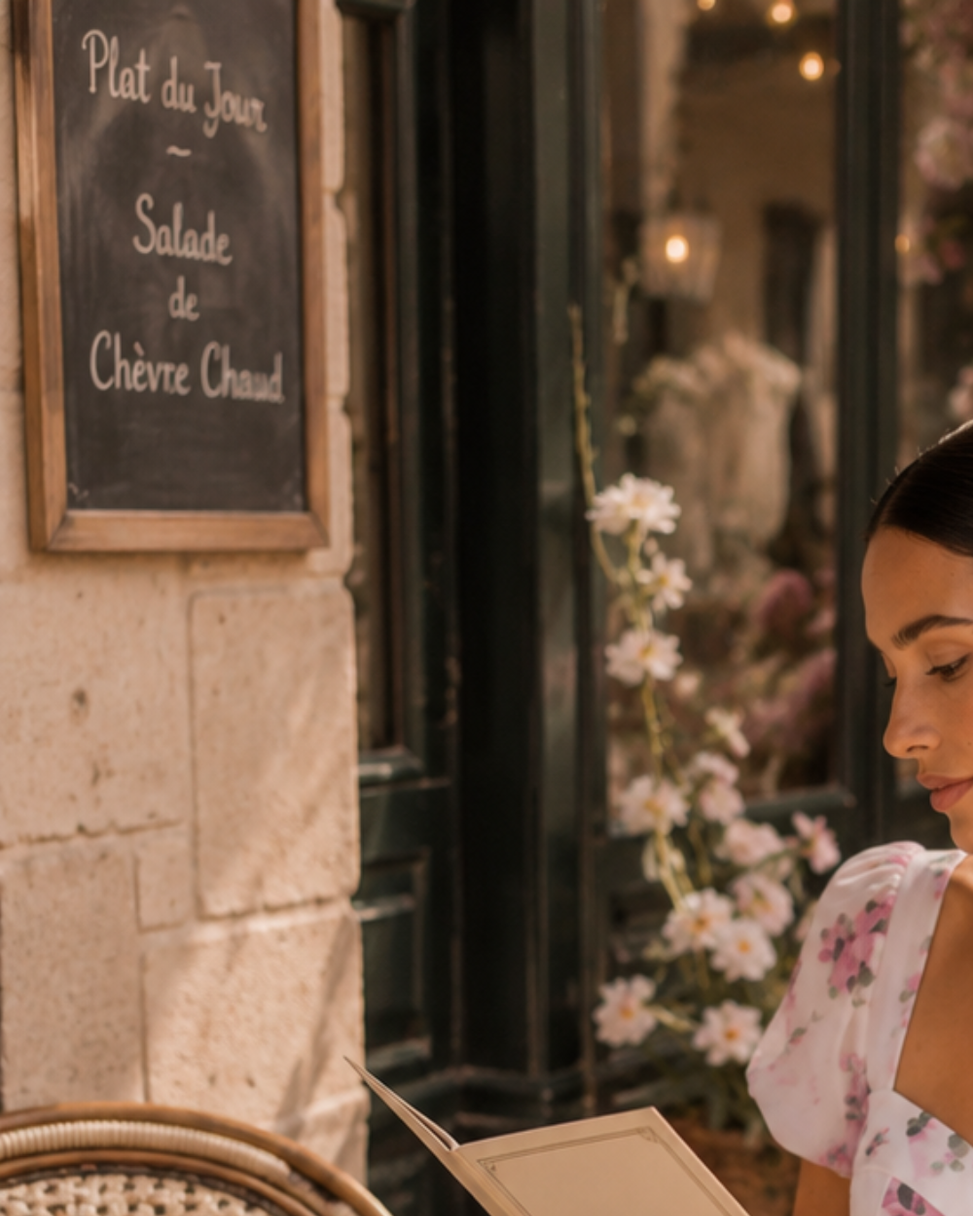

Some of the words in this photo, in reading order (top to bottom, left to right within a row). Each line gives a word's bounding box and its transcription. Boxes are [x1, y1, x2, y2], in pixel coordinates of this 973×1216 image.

[81, 29, 151, 103] Plat
[161, 55, 197, 113] du
[203, 61, 267, 139] Jour
[132, 192, 233, 266] Salade
[168, 275, 200, 321] de
[89, 329, 191, 396] Chèvre
